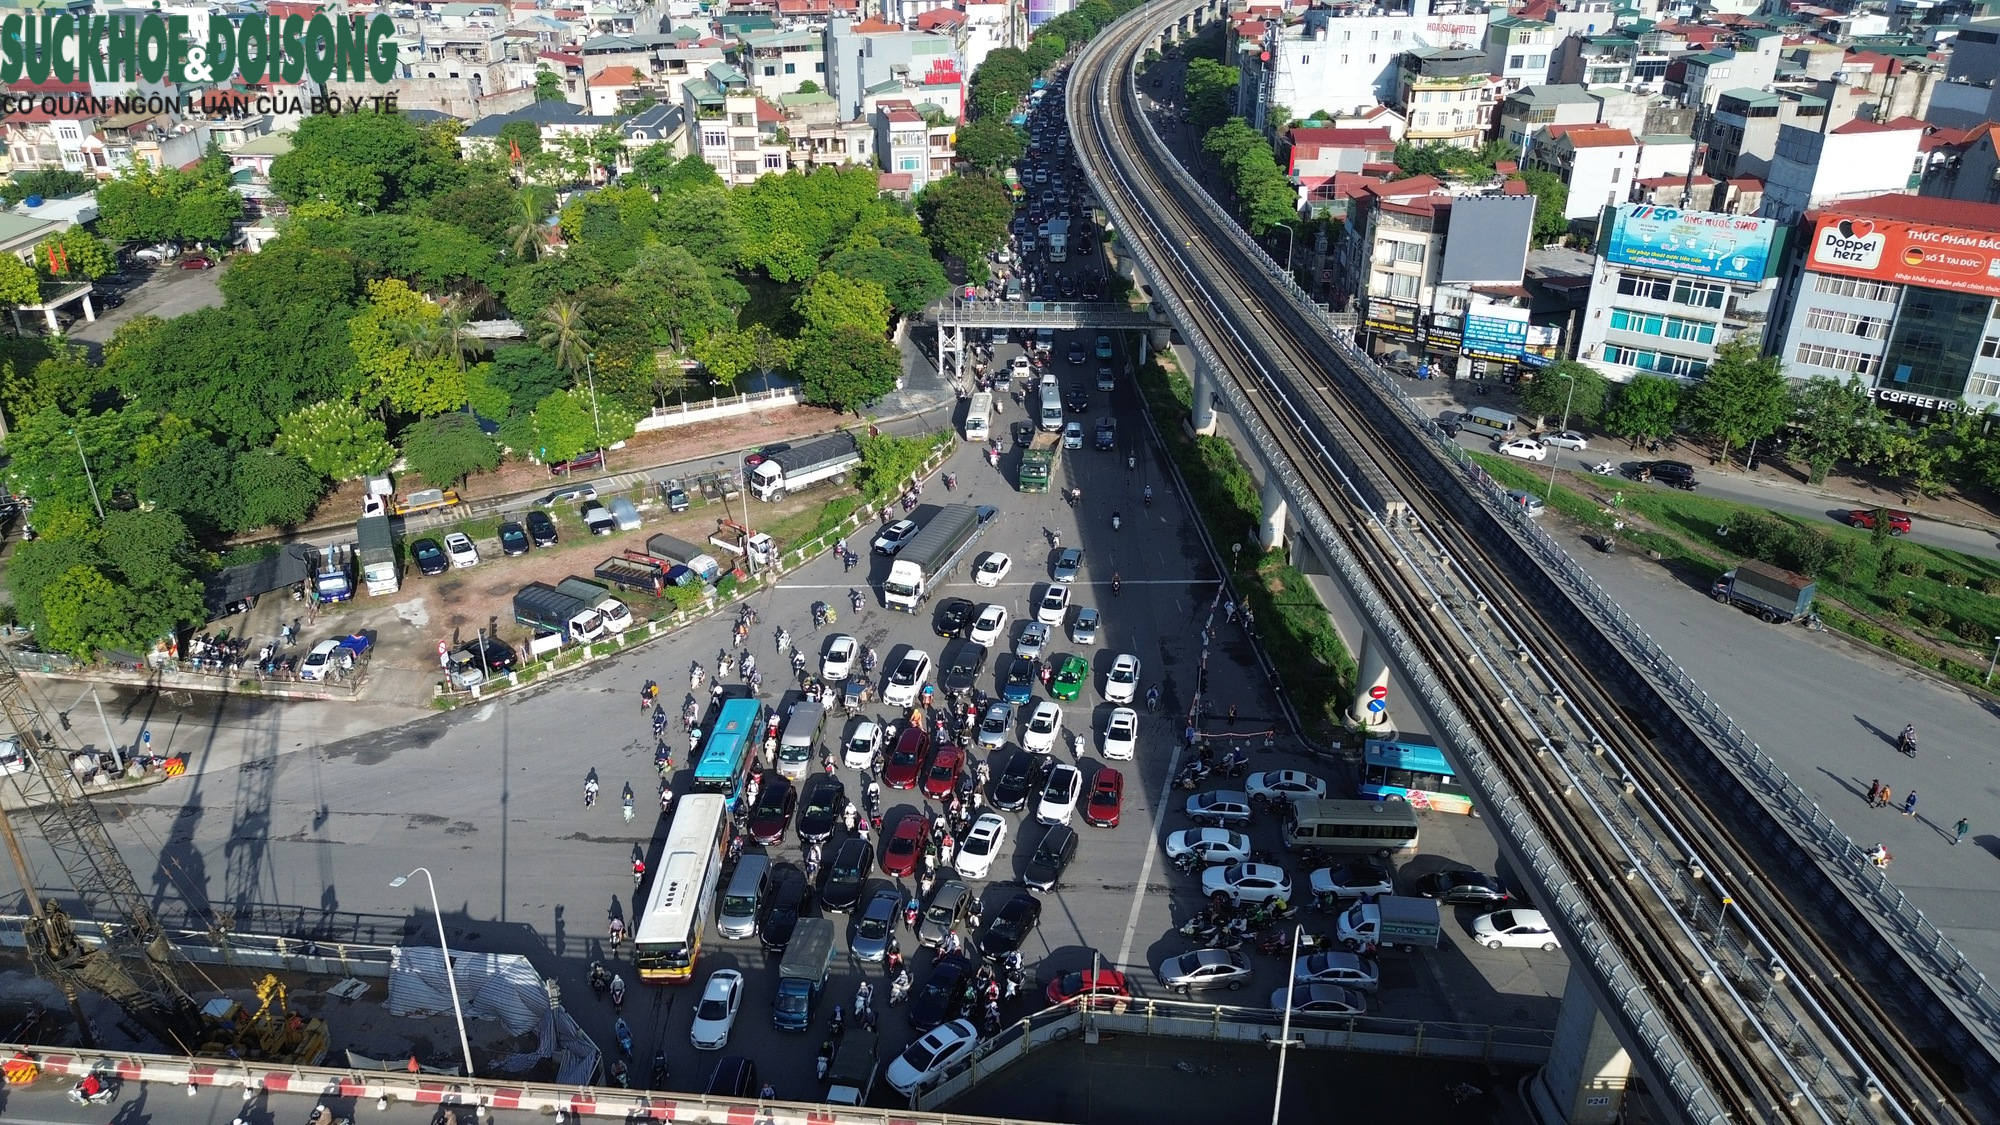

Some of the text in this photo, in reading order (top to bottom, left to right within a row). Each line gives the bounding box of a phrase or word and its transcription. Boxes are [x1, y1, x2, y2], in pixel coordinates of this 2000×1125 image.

[1427, 23, 1440, 32] HOA
[1456, 24, 1477, 34] HOTEL
[933, 57, 954, 71] VÀNG
[1653, 208, 1678, 221] SP
[1734, 220, 1758, 231] SINO
[1825, 234, 1877, 252] Doppel
[1908, 230, 1940, 243] THỰC
[1832, 248, 1863, 262] herz
[1938, 254, 1945, 263] 1
[1946, 257, 1959, 266] TẠI
[1894, 272, 1912, 282] Nhập
[1928, 276, 1936, 284] và
[1880, 390, 1934, 409] COFFEE
[1587, 1097, 1608, 1105] P241
